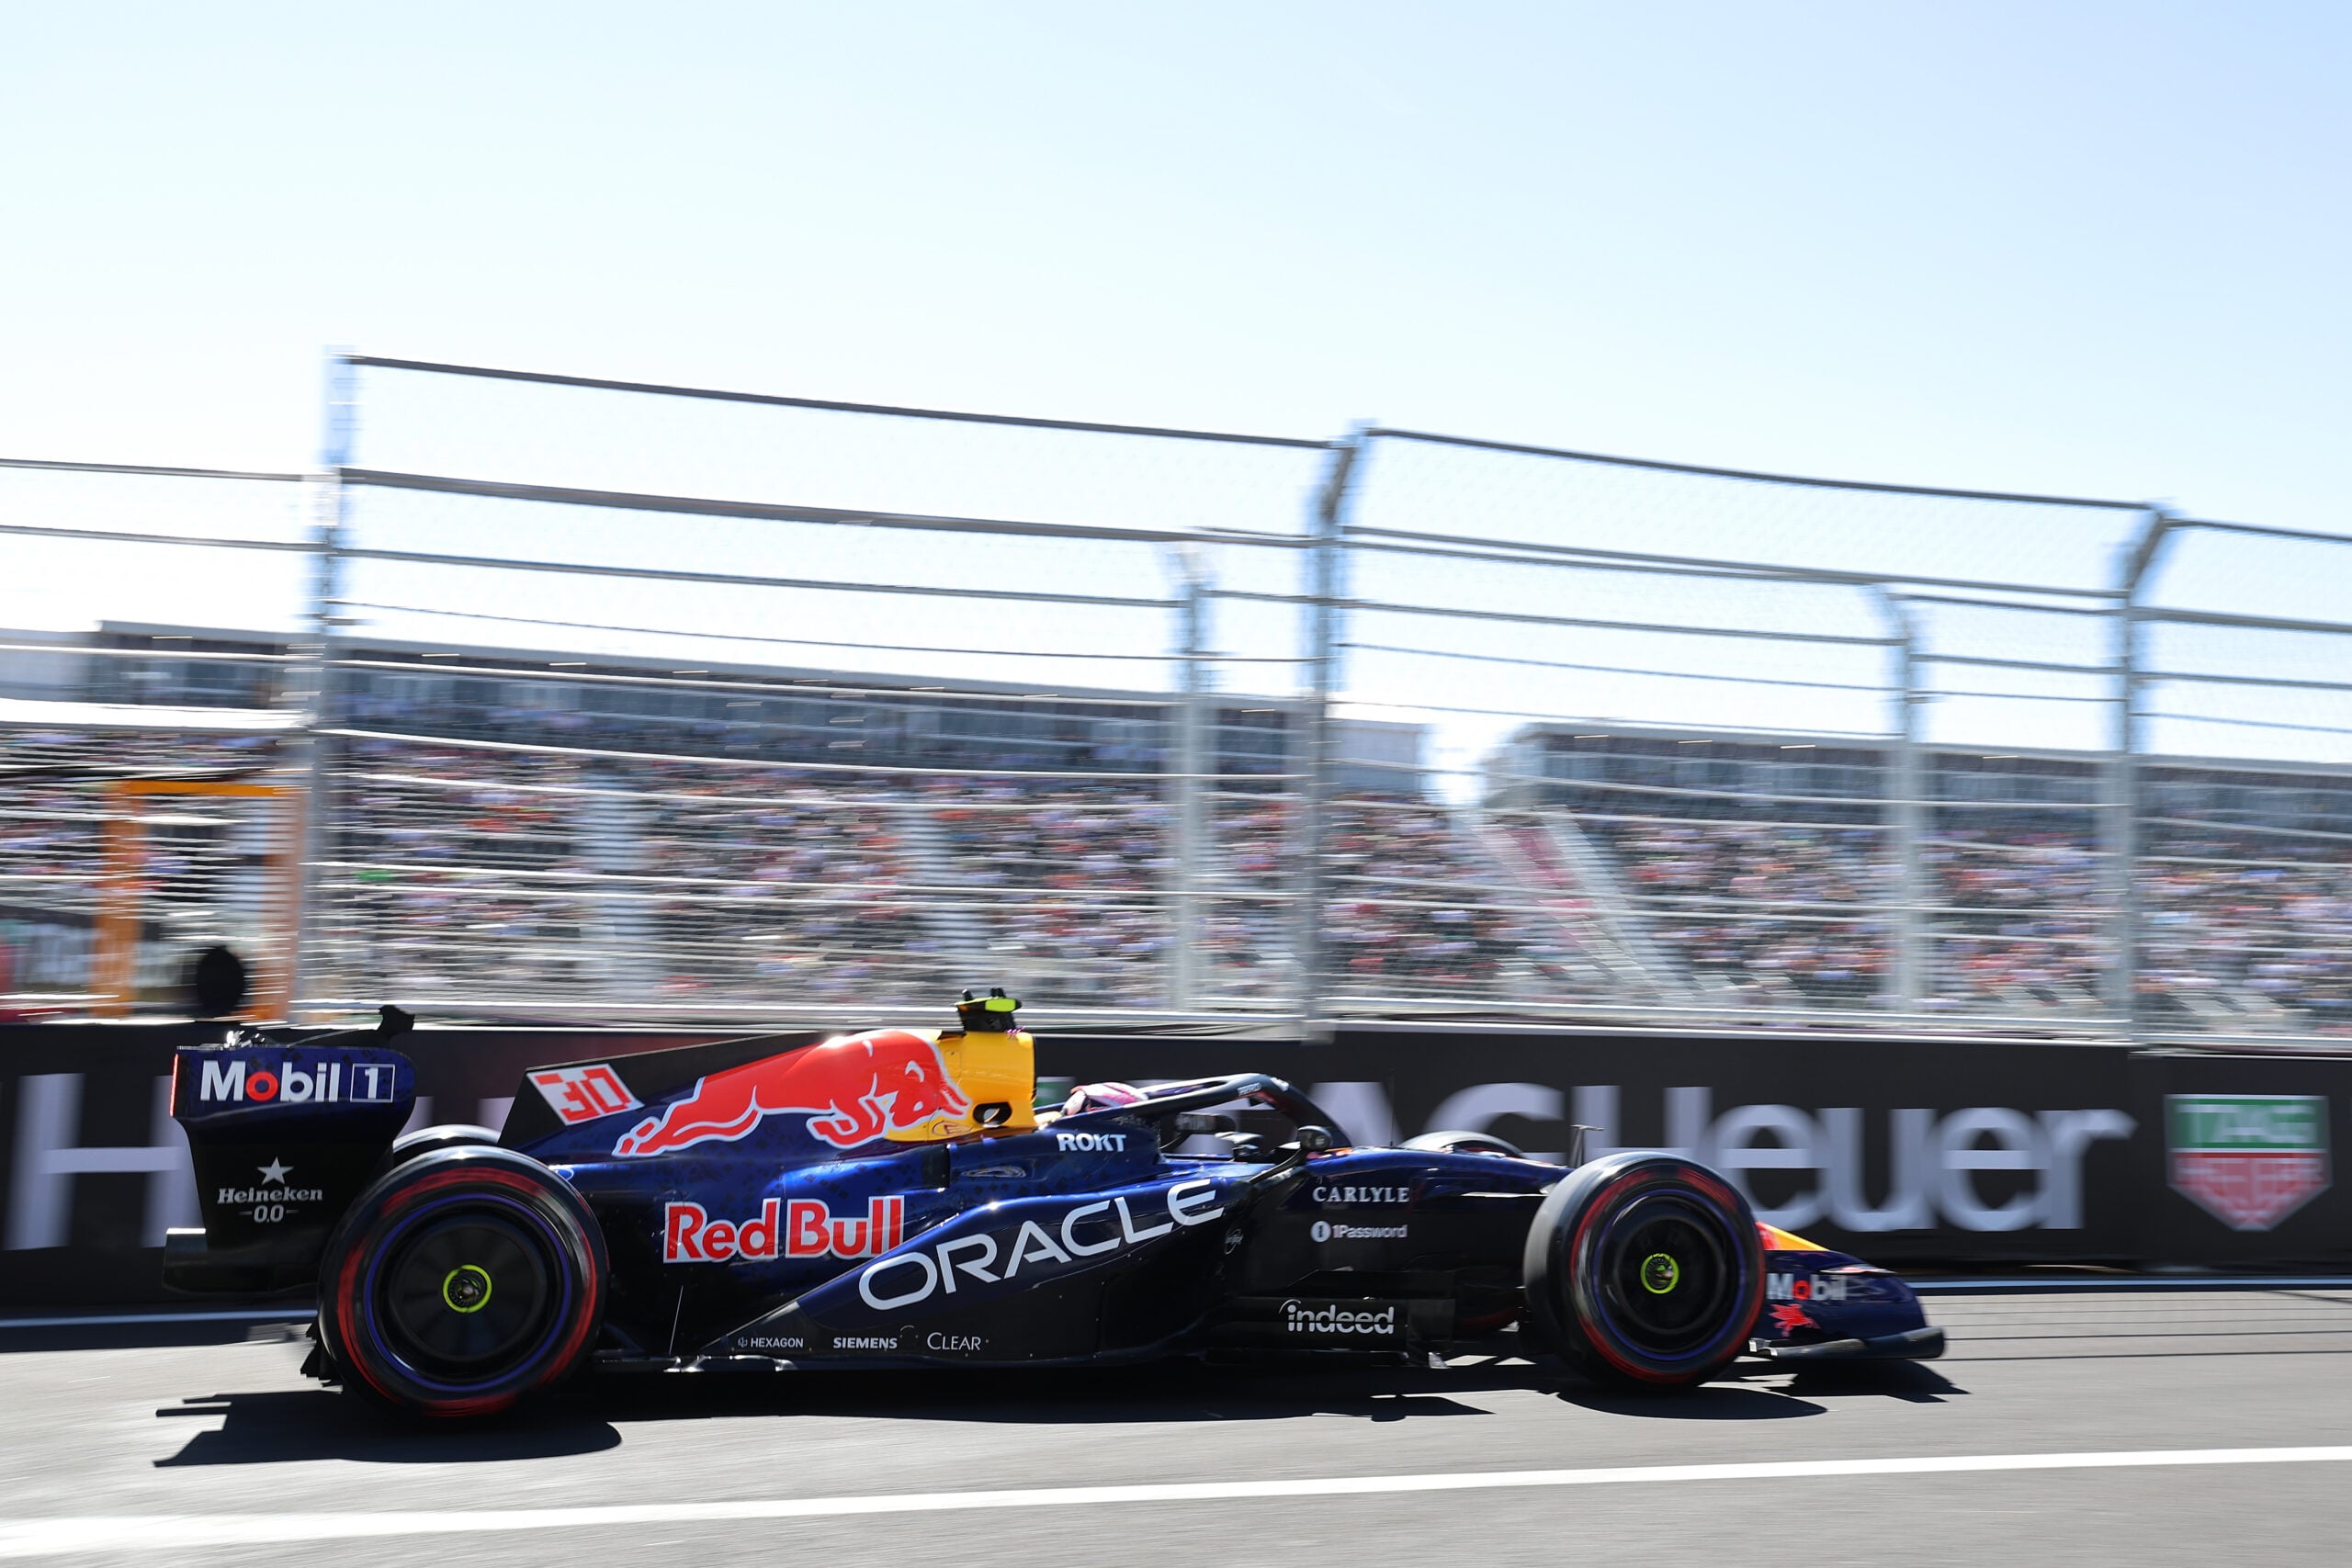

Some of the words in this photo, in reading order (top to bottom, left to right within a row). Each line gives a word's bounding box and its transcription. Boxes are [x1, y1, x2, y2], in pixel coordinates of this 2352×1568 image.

[199, 1060, 341, 1102] Mobil
[364, 1067, 379, 1100] 1
[1057, 1134, 1126, 1152] ROKT
[217, 1187, 323, 1204] Heineken
[1313, 1187, 1409, 1202] CARLYLE
[663, 1197, 781, 1264] Red
[786, 1195, 905, 1259] Bull
[859, 1179, 1224, 1310] ORACLE
[1767, 1272, 1848, 1301] Mobil
[1287, 1303, 1395, 1334] indeed
[751, 1337, 804, 1348] HEXAGON
[833, 1337, 898, 1349] SIEMENS
